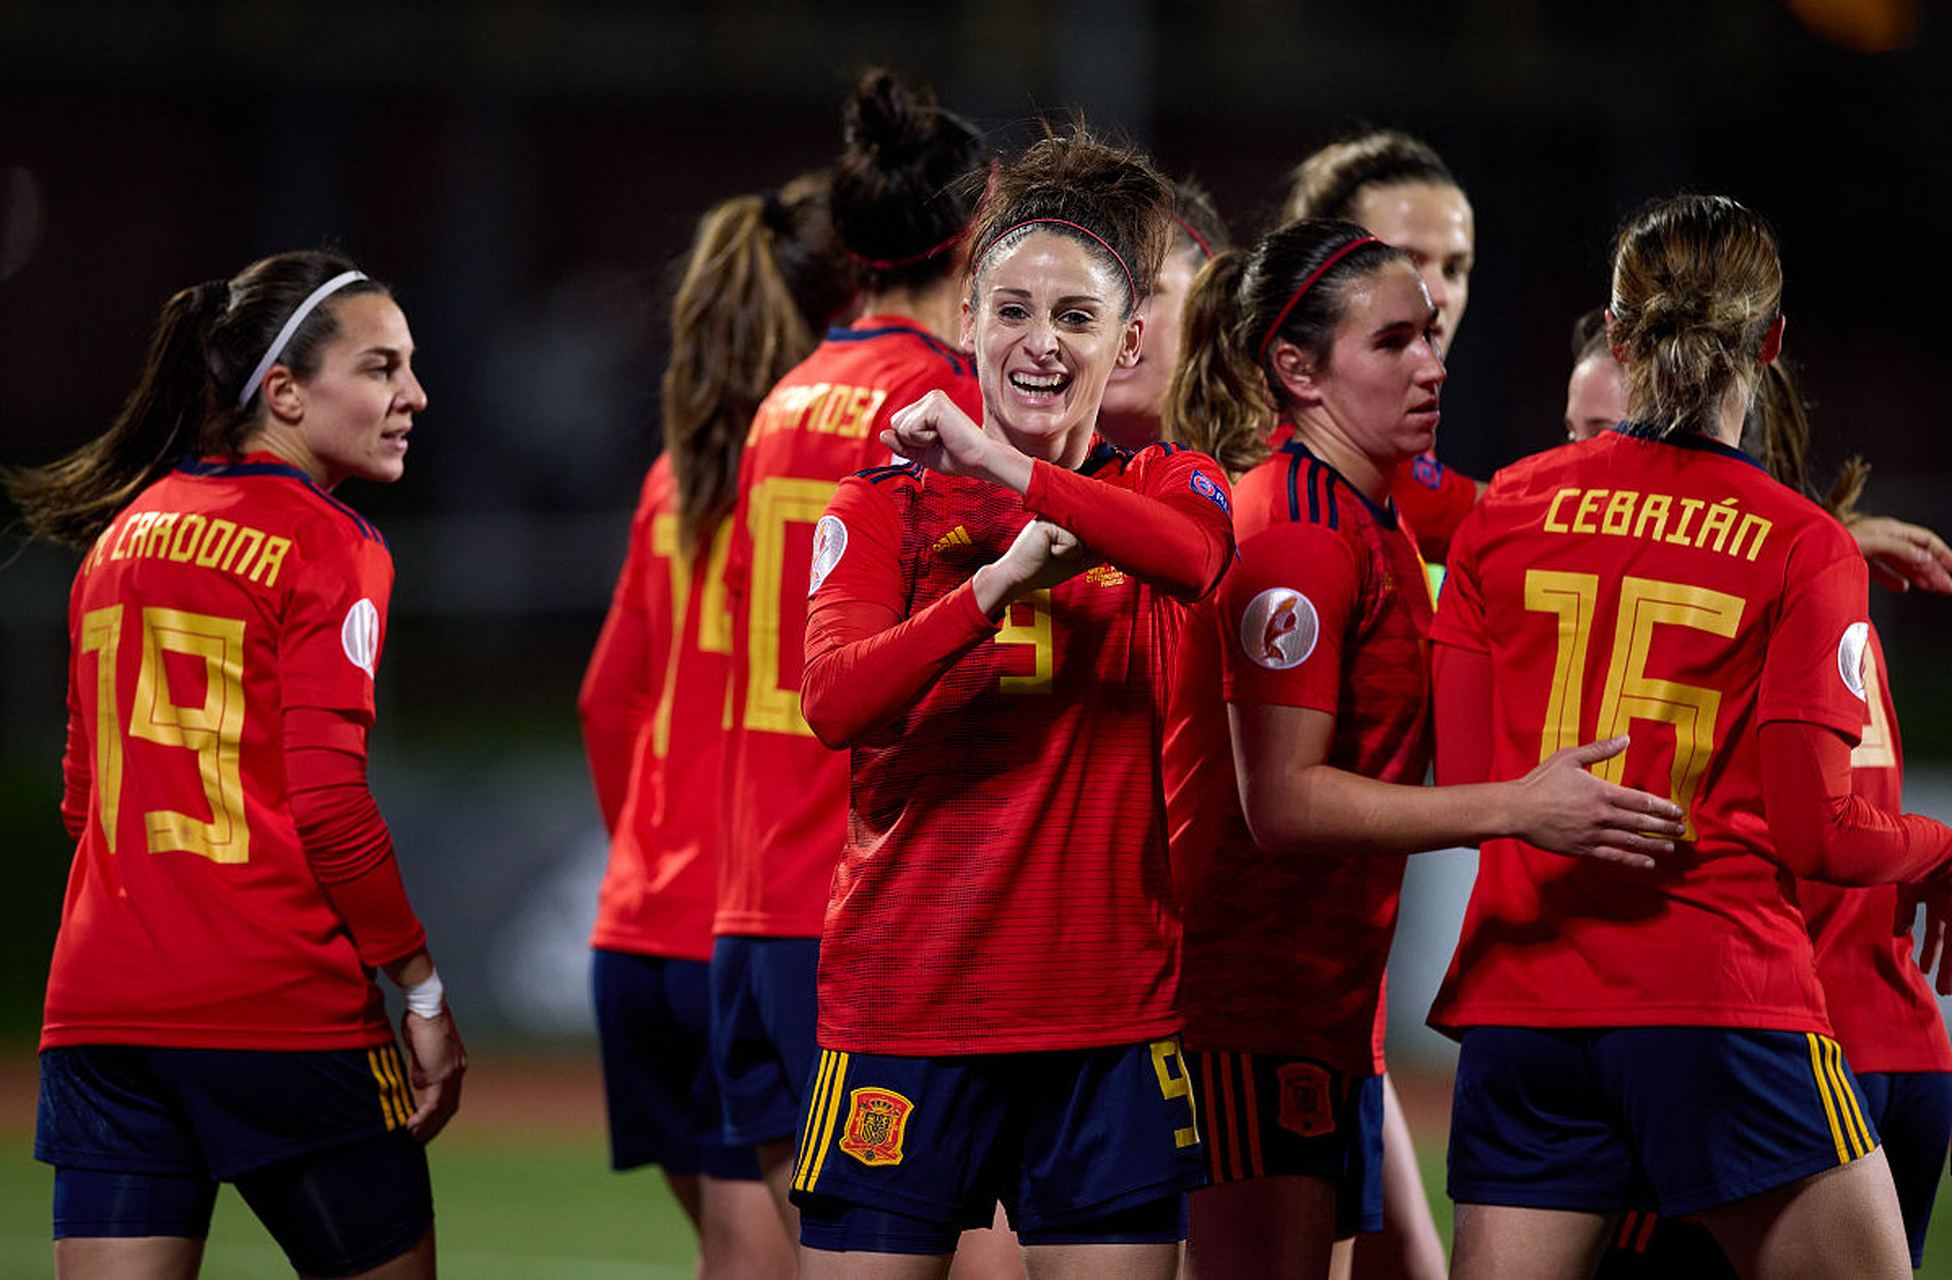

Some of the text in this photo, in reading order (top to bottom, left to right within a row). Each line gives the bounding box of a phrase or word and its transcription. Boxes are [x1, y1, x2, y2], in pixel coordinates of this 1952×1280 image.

[110, 511, 293, 588] CARDONA
[1543, 487, 1774, 562] CEBRIÁN
[994, 588, 1052, 694] 9
[81, 603, 251, 864] 19
[1523, 568, 1747, 843] 16
[1149, 1036, 1201, 1149] 9
